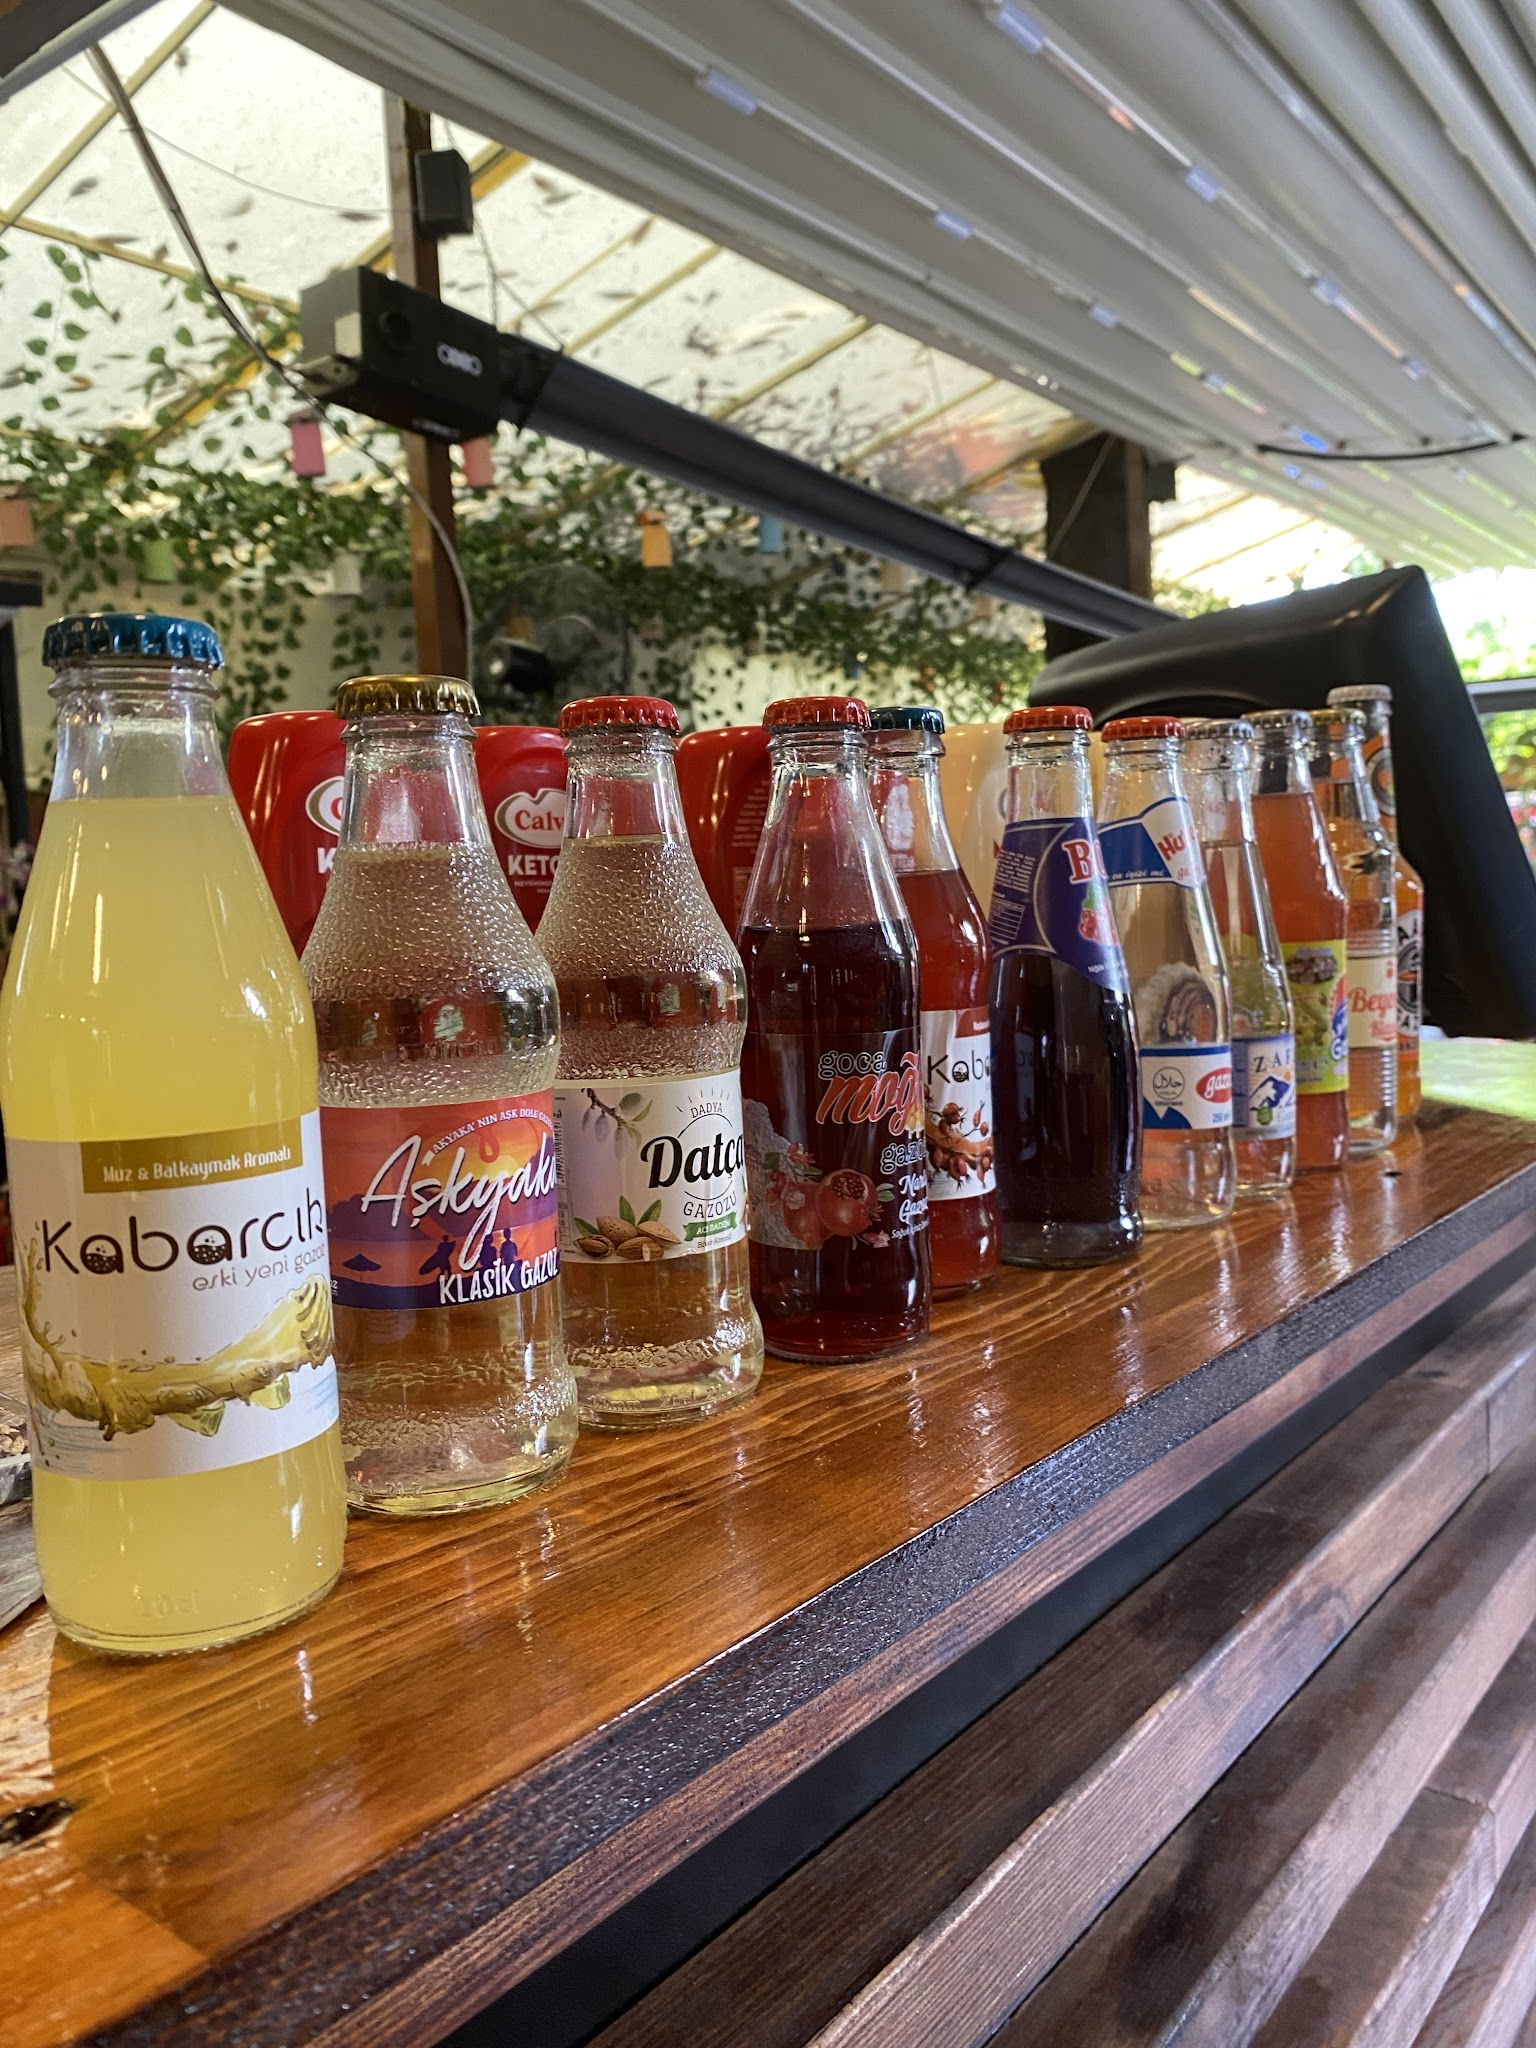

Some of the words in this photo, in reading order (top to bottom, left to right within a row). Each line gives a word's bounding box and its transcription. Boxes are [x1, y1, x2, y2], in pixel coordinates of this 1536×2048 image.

[690, 1102, 723, 1119] DADYA
[103, 1163, 133, 1183] Muz
[138, 1167, 149, 1181] &
[153, 1155, 241, 1180] Balkaymak
[640, 1133, 743, 1189] Datça
[683, 1191, 736, 1218] GAZOZU
[192, 1267, 237, 1292] eski
[245, 1255, 289, 1287] yeni
[439, 1258, 516, 1304] KLASİK
[520, 1247, 559, 1290] GAZOZ
